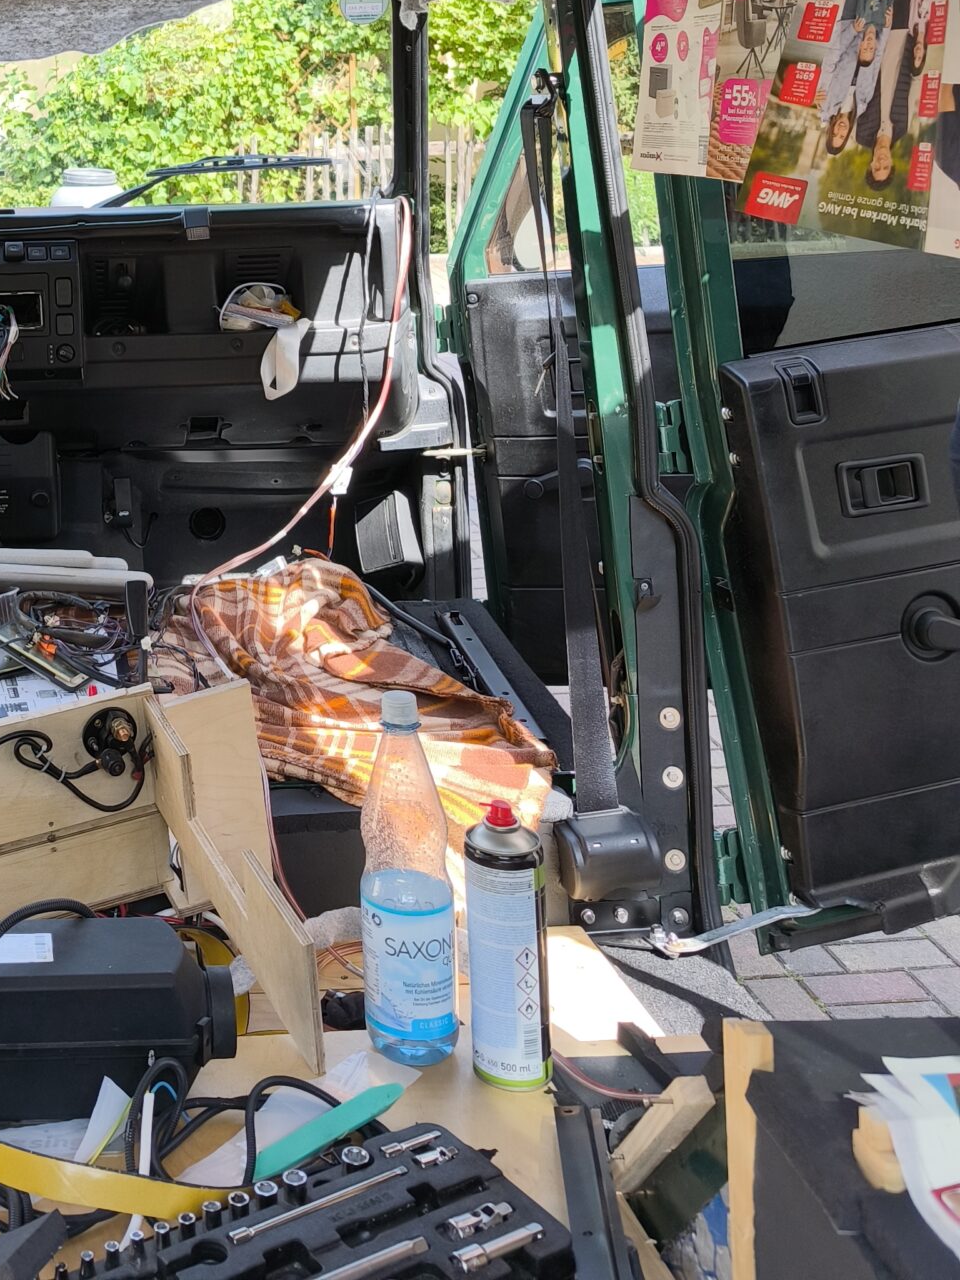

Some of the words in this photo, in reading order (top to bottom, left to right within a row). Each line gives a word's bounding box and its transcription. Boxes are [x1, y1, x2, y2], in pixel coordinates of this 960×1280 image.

[756, 187, 800, 209] AWG
[827, 191, 856, 205] Familie
[856, 196, 884, 207] ganze
[818, 201, 842, 216] AWG
[842, 206, 859, 220] bei
[884, 201, 898, 212] die
[898, 203, 909, 214] für
[860, 209, 898, 226] Marken
[900, 216, 927, 232] Starke
[500, 1062, 517, 1072] 500
[519, 1063, 531, 1073] ml
